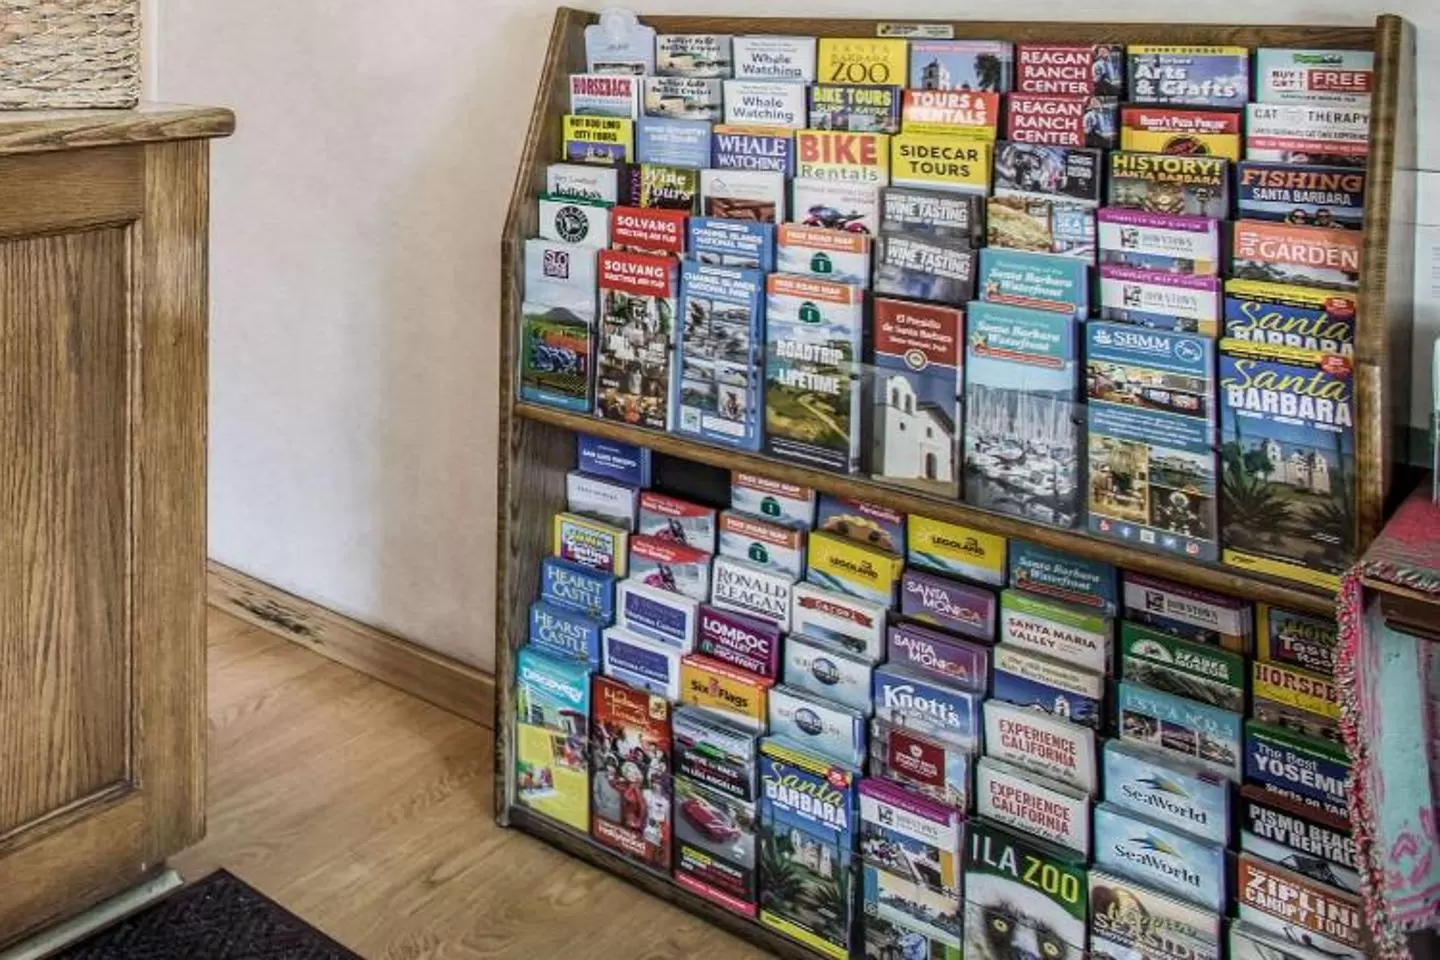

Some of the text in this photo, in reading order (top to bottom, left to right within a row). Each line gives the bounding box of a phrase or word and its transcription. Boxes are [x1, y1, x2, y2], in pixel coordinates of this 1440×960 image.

[752, 53, 791, 65] Whale
[1021, 51, 1090, 65] REAGAN
[742, 64, 802, 77] Watching
[831, 62, 890, 83] ZOO
[1025, 67, 1086, 79] RANCH
[1135, 65, 1186, 79] Arts
[1312, 72, 1366, 85] FREE
[813, 88, 891, 106] BIKE TOURS
[1023, 81, 1089, 94] CENTER
[1136, 80, 1236, 97] & Crafts
[743, 96, 784, 108] Whale
[911, 93, 986, 109] TOURS &
[1011, 102, 1082, 115] REAGAN
[733, 107, 794, 121] Watching
[910, 108, 986, 125] RENTALS
[1015, 116, 1078, 129] RANCH
[1255, 110, 1369, 123] CAT THERAPY
[719, 136, 786, 157] WHALE
[1012, 131, 1079, 145] CENTER
[800, 134, 878, 165] BIKE
[900, 145, 978, 161] SIDECAR
[717, 155, 786, 171] WATCHING
[802, 165, 878, 181] Rentals
[909, 162, 970, 177] TOURS
[1112, 155, 1221, 175] HISTORY!
[642, 168, 687, 185] Wine
[1113, 170, 1221, 185] SANTA BARBARA
[1241, 169, 1363, 190] FISHING
[646, 183, 694, 203] Tours
[1252, 189, 1352, 206] SANTA BARBARA
[920, 203, 968, 221] TASTING
[617, 216, 677, 232] SOLVANG
[888, 246, 916, 260] WINE
[921, 252, 970, 273] TASTING
[1260, 241, 1359, 268] GARDEN
[604, 260, 664, 278] SOLVANG
[1228, 301, 1352, 341] Santa
[777, 340, 843, 365] ROADTRIP
[778, 369, 841, 395] LIFETIME
[1221, 359, 1350, 402] Santa
[1228, 385, 1352, 427] BARBARA
[932, 536, 985, 556] LEGOLAND
[830, 557, 878, 578] LEGOLAND
[548, 567, 601, 591] HEARST
[717, 566, 787, 599] RONALD
[553, 581, 602, 604] CASTLE
[716, 582, 785, 613] REAGAN
[907, 581, 950, 602] SANTA
[923, 594, 980, 620] MONICA
[535, 610, 590, 639] HEARST
[704, 616, 769, 653] LOMPOC
[1008, 618, 1096, 649] SANTA MARIA
[539, 626, 589, 654] CASTLE
[720, 637, 751, 653] VALLEY
[893, 634, 935, 654] SANTA
[1009, 629, 1055, 647] VALLEY
[910, 649, 968, 678] MONICA
[1256, 664, 1337, 700] HORSEB
[883, 685, 959, 727] Knott's
[999, 719, 1076, 755] EXPERIENCE
[1002, 734, 1076, 769] CALIFORNIA
[1257, 743, 1318, 770] The Best
[763, 763, 844, 806] Santa
[1253, 752, 1349, 798] YOSEMI
[765, 780, 848, 828] BARBARA
[990, 780, 1070, 820] EXPERIENCE
[1121, 784, 1208, 824] SeaWorld
[1305, 799, 1319, 807] on
[1324, 802, 1349, 818] YAR
[992, 796, 1069, 835] CALIFORNIA
[1249, 803, 1354, 852] PISMO BEAC
[1254, 820, 1285, 841] ATV
[1114, 844, 1201, 887] SeaWorld
[1023, 855, 1078, 904] ZOO
[1245, 887, 1307, 923] CANOPY
[1248, 874, 1359, 929] ZIPLIN
